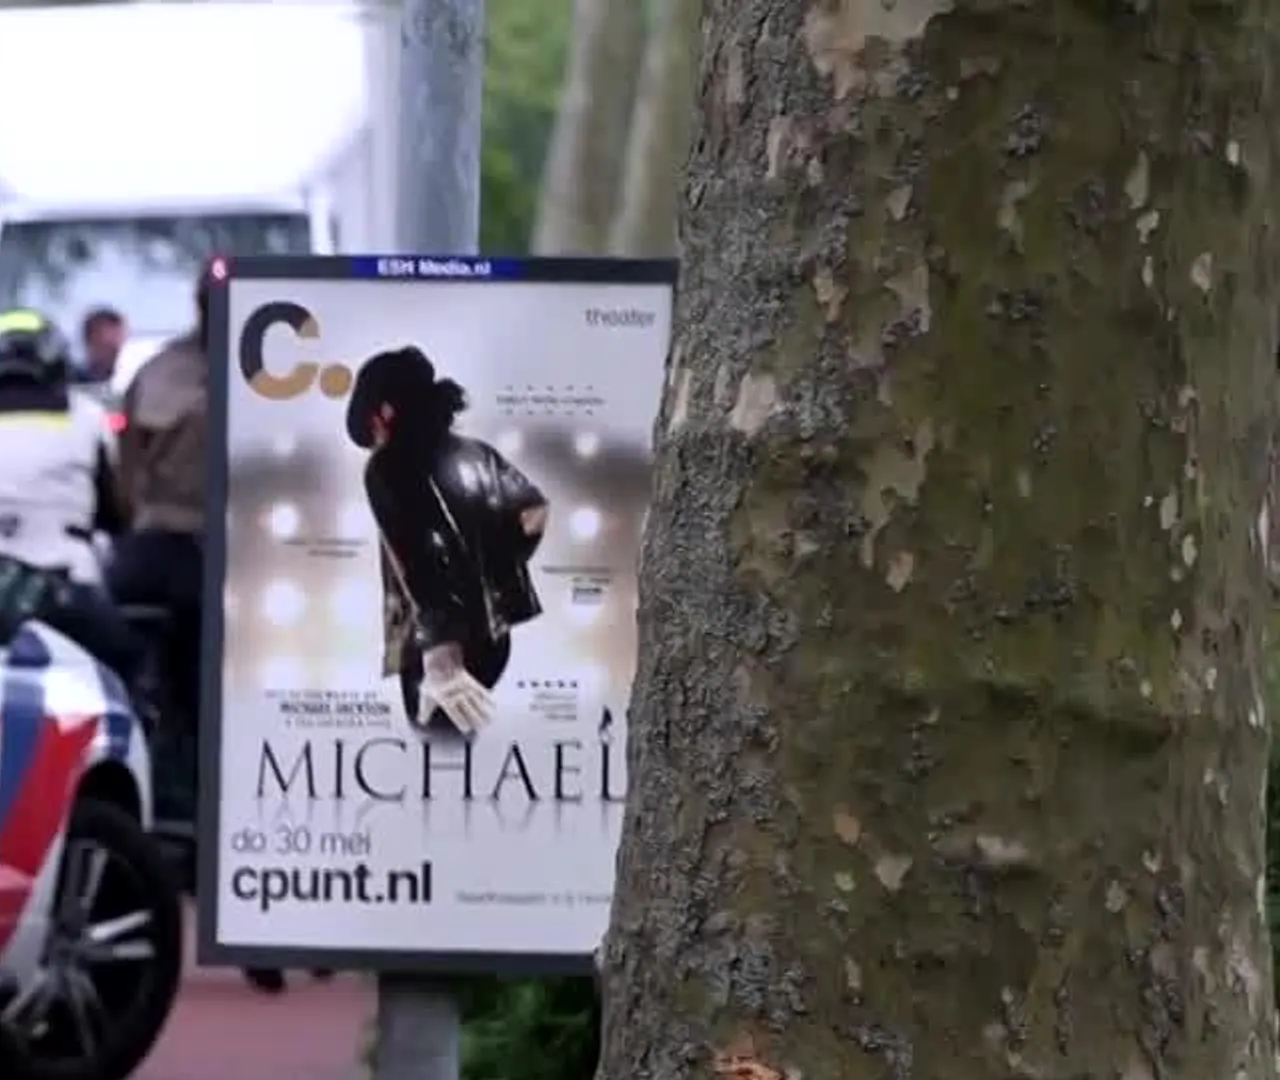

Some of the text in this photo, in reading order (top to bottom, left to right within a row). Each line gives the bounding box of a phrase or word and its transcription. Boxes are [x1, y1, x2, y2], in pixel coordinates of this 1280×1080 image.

[585, 307, 657, 328] theater
[256, 736, 626, 802] MICHAEL
[231, 824, 371, 855] do 30 mei
[232, 861, 433, 912] cpunt.nl
